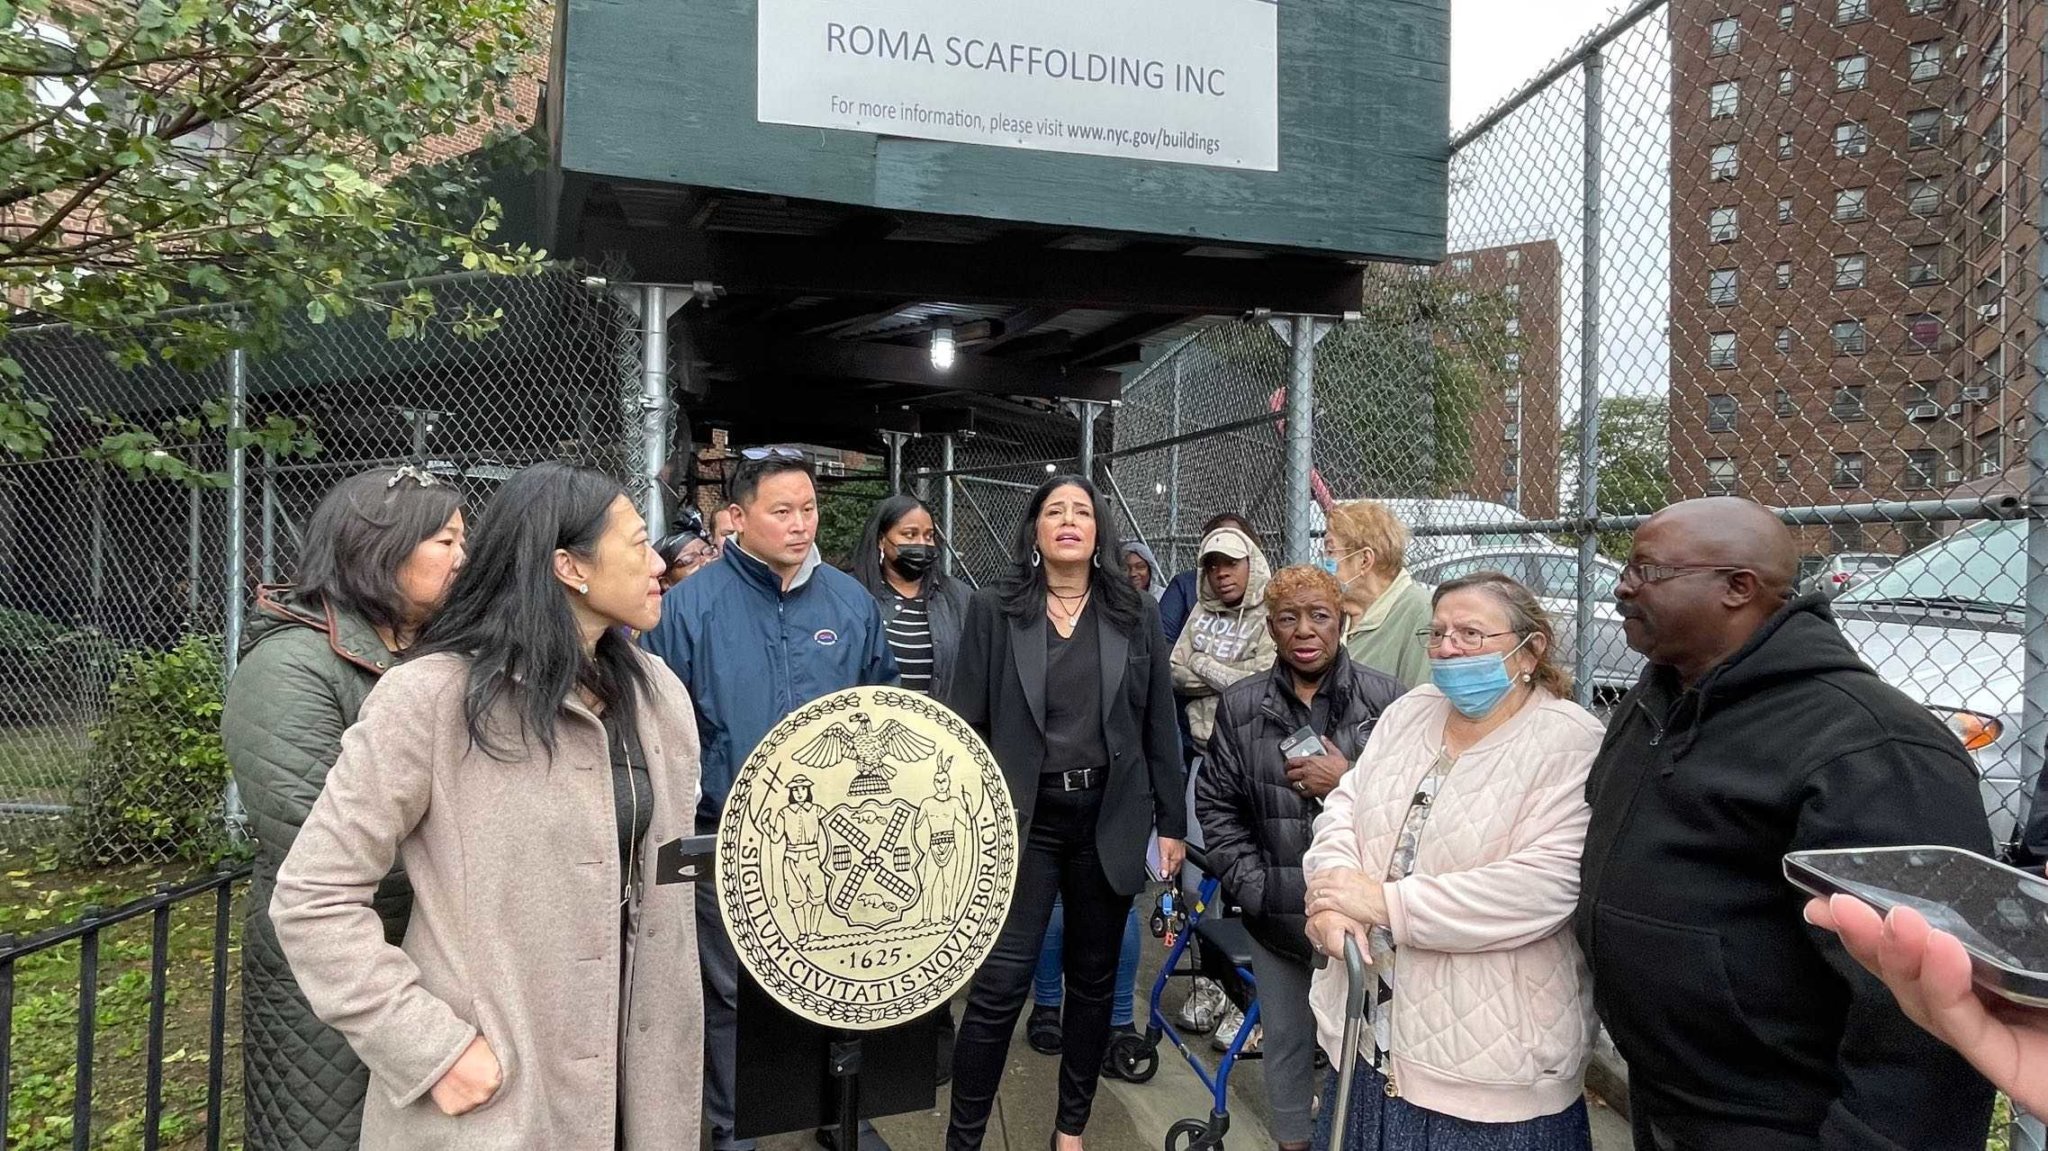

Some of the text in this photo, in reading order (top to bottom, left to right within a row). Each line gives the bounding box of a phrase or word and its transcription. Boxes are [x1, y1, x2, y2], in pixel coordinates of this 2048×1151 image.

[827, 22, 1225, 96] ROMA SCAFFOLDING INC
[831, 95, 1220, 153] For more information, please visit www.nyc.gov/buildings
[740, 825, 998, 1002] SIGILLUM CIVITATIS NOVI EBORACI
[849, 947, 903, 970] 1625
